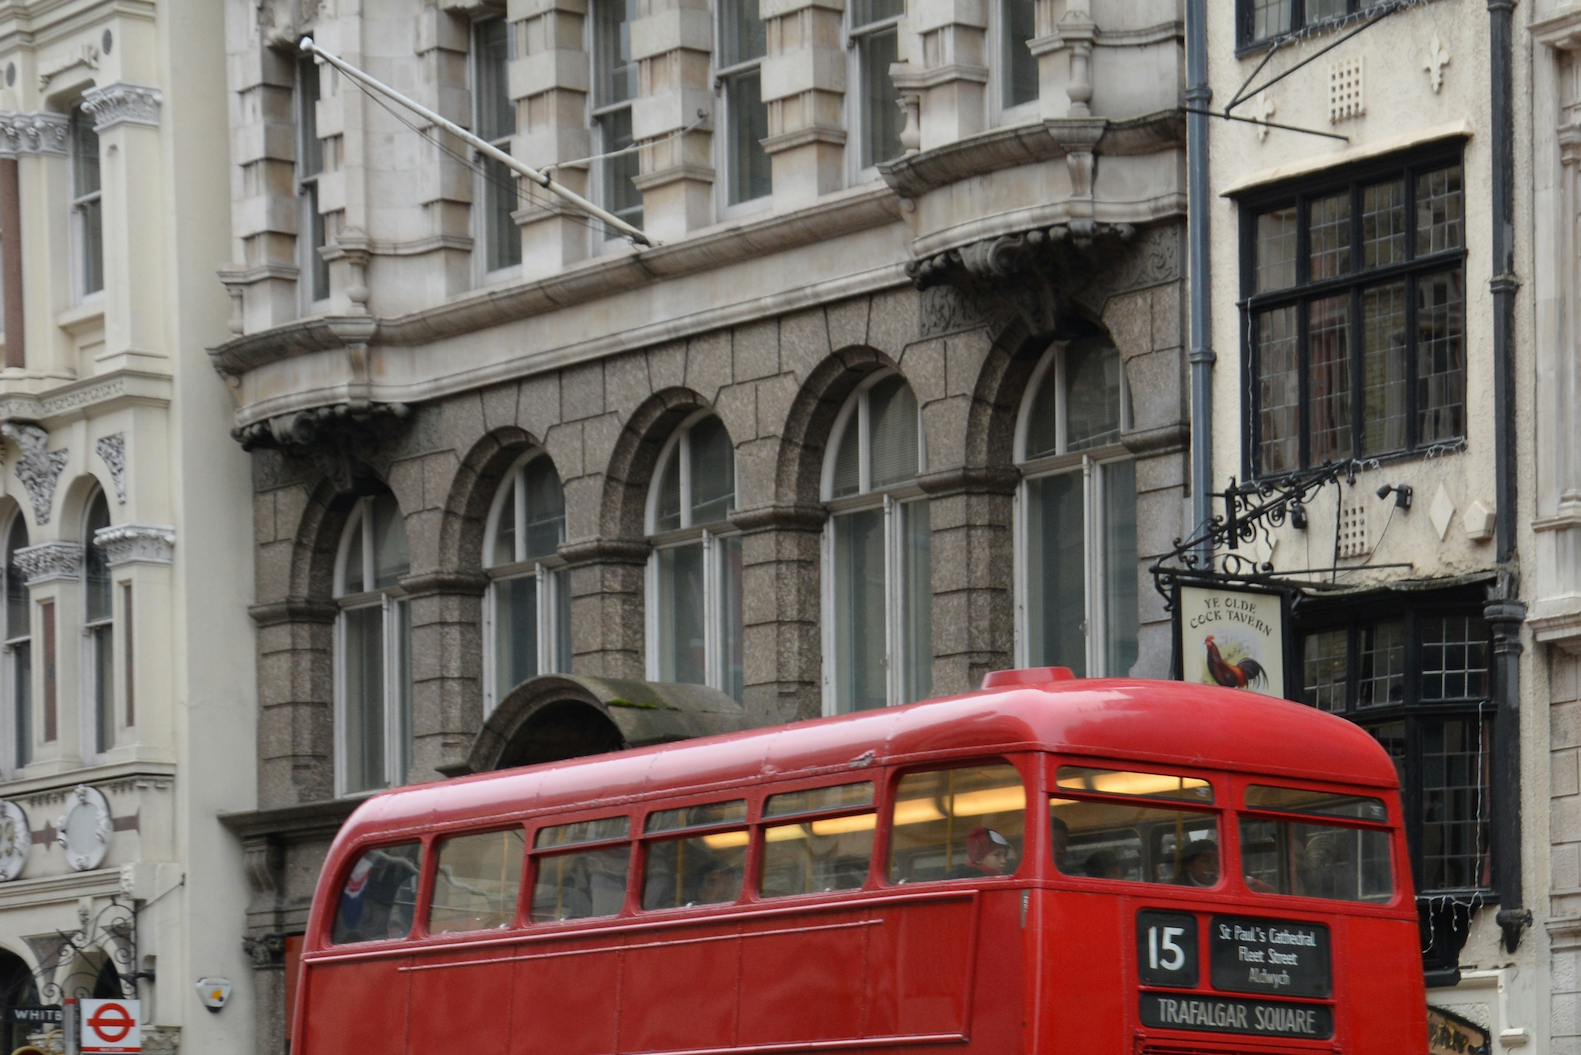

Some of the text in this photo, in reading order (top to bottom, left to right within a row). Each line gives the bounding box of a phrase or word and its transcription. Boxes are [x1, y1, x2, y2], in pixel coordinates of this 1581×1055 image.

[1204, 597, 1257, 614] YE OLDE
[1190, 610, 1272, 636] COCK TAVERN
[1219, 923, 1317, 947] St Paul's Cathedral
[1148, 925, 1186, 971] 15
[1238, 946, 1299, 966] Fleet Street
[1248, 967, 1291, 989] Aldwych
[14, 1009, 63, 1021] WHITB
[1157, 998, 1316, 1034] TRAFALGAR SQUARE
